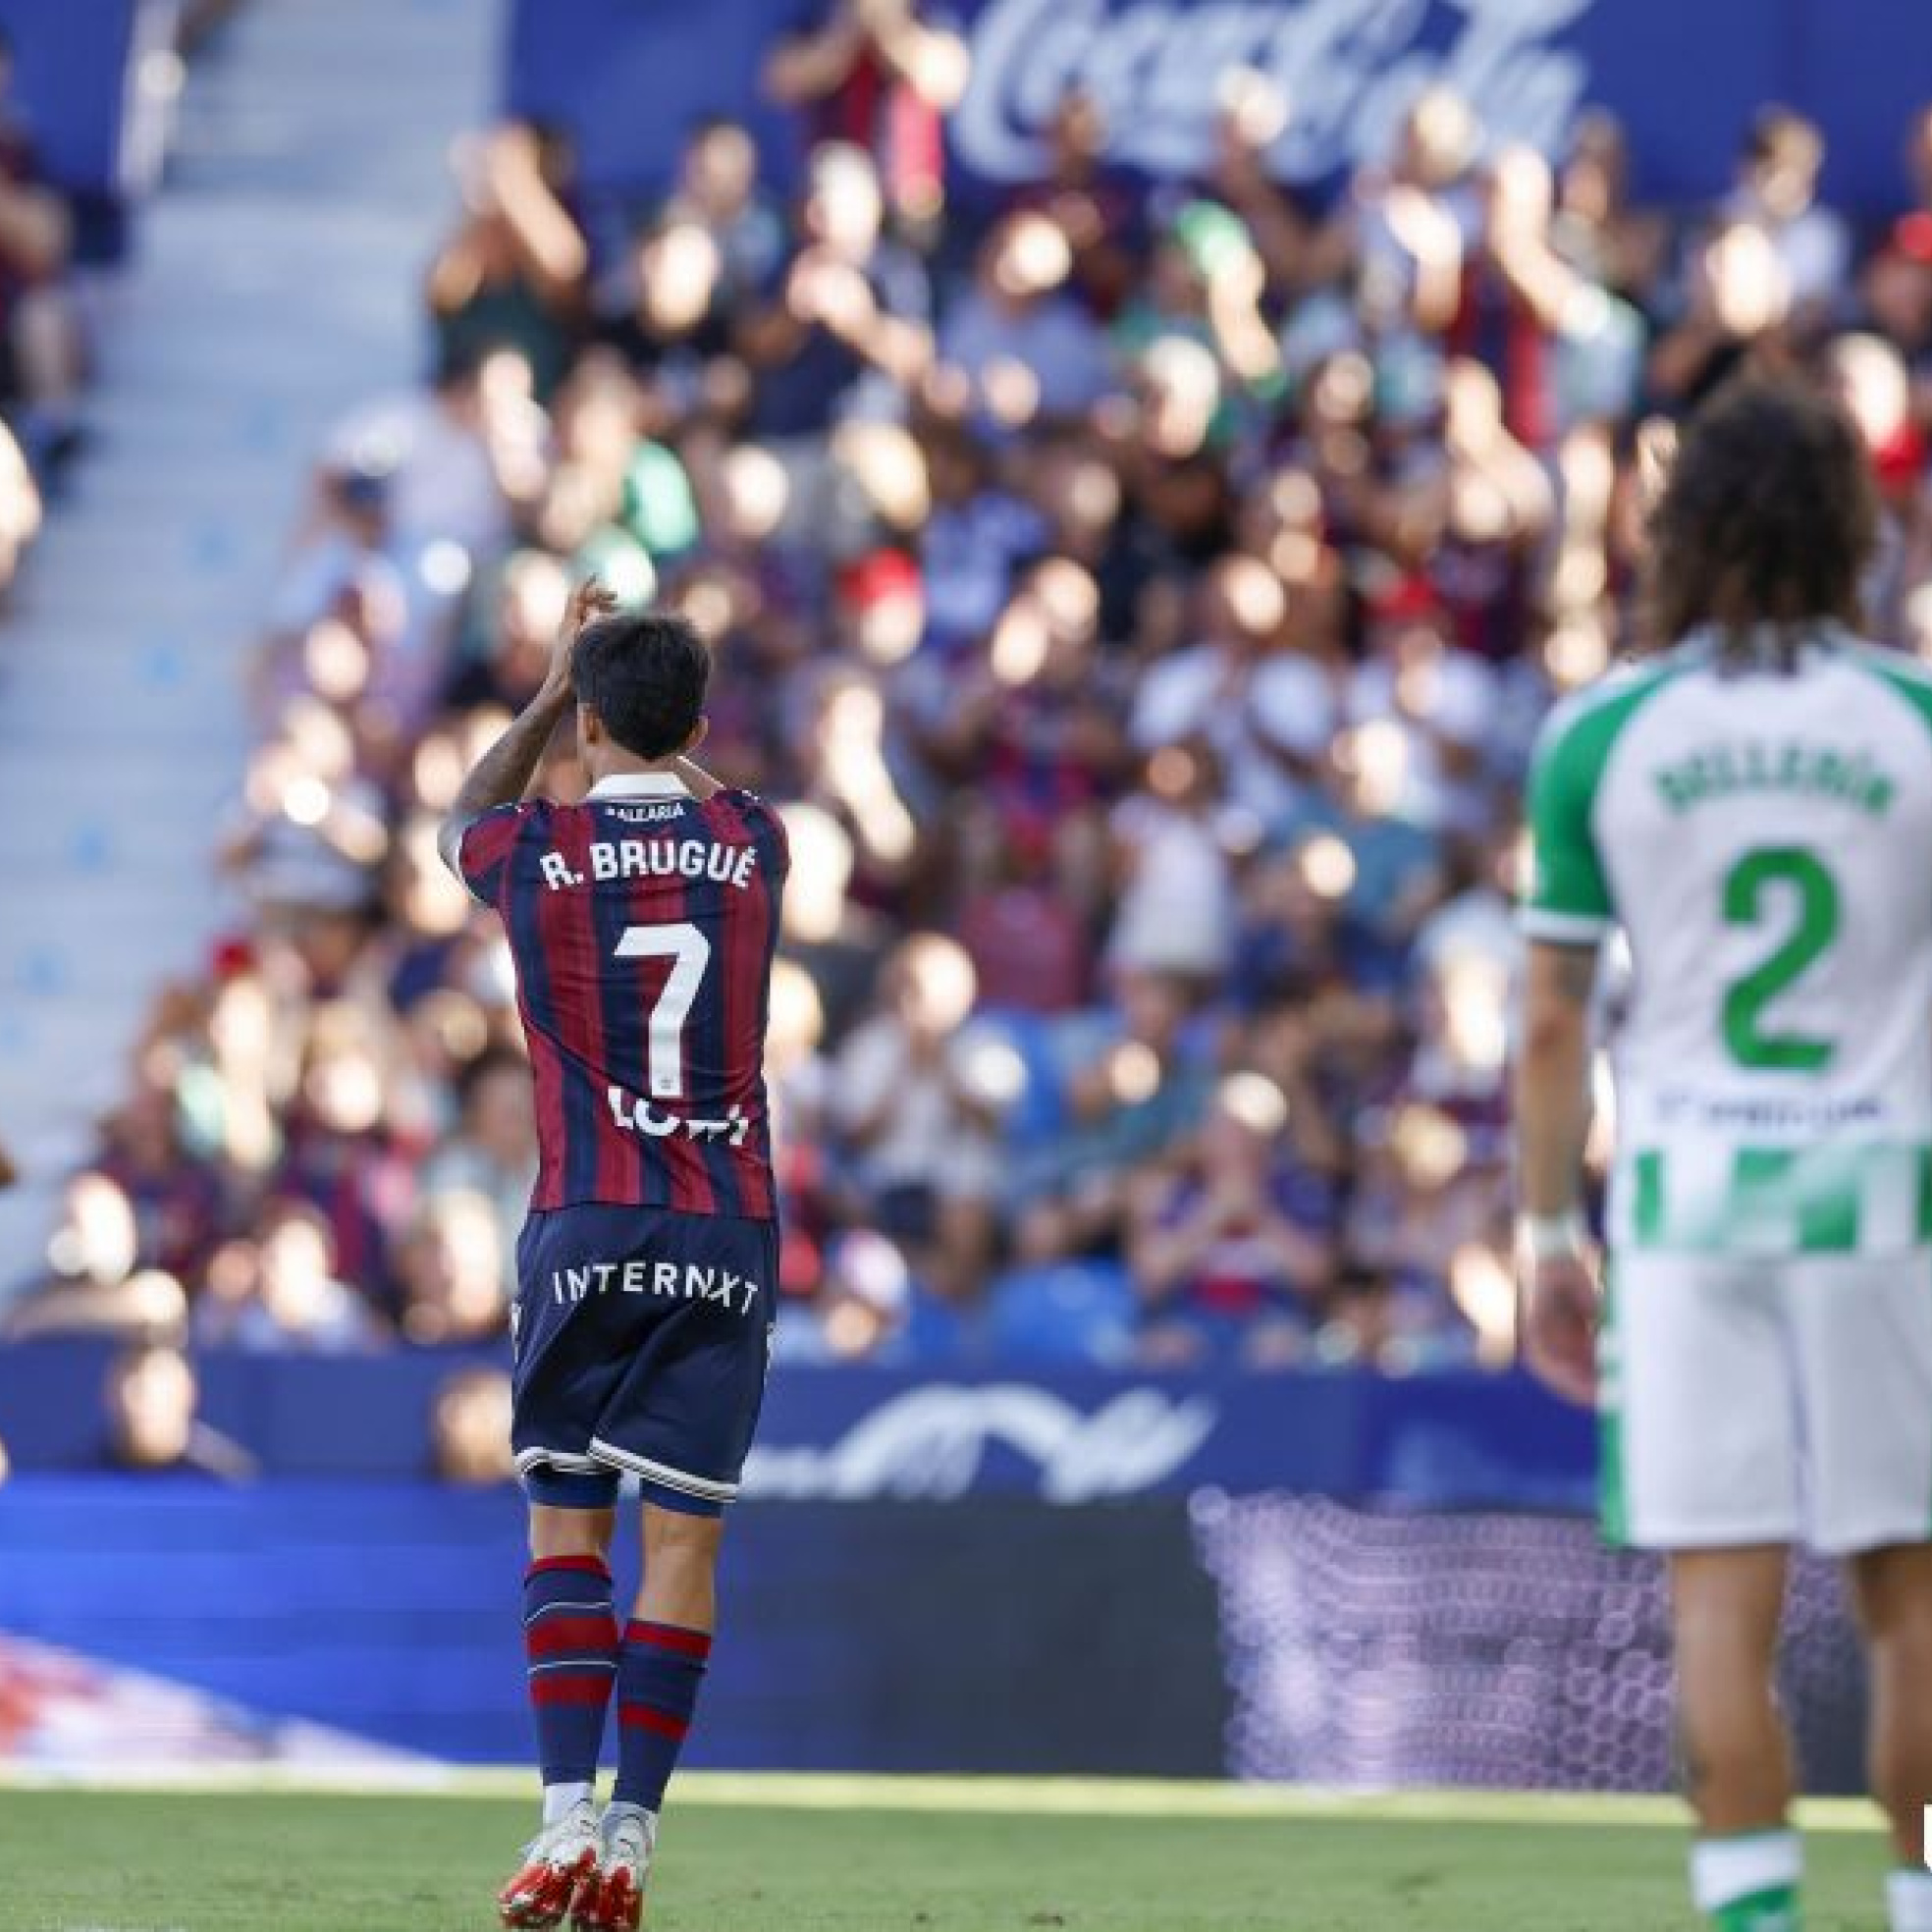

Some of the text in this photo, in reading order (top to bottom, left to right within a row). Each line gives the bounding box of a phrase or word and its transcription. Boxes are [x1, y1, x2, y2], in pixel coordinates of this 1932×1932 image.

[540, 840, 757, 890] R. BRUGUÉ
[613, 922, 711, 1099] 7
[1723, 844, 1840, 1071] 2
[552, 1261, 759, 1315] INTERNXT
